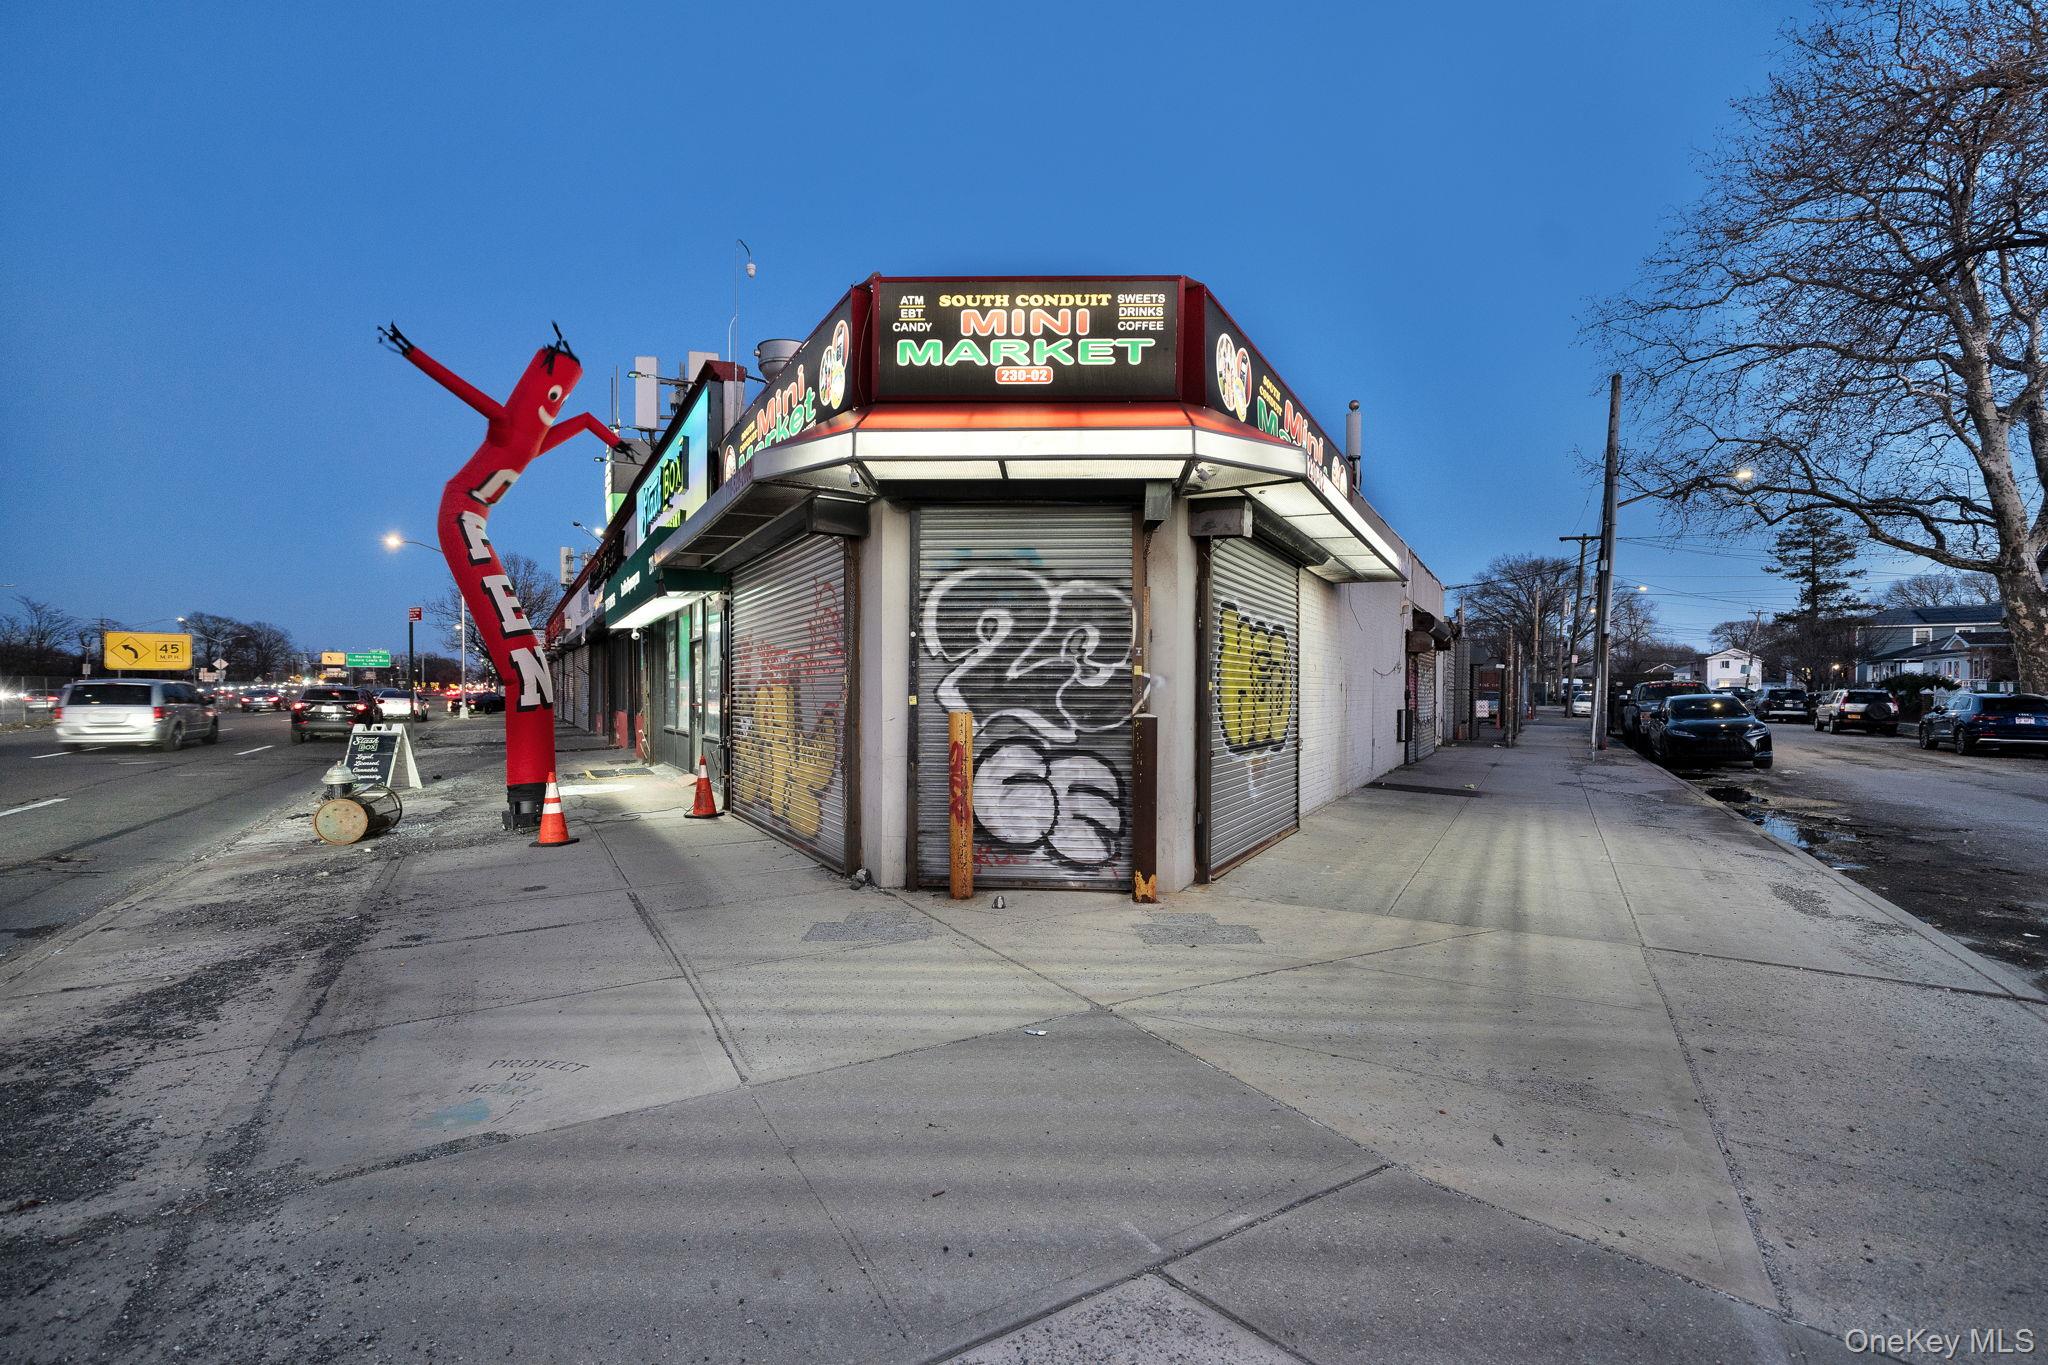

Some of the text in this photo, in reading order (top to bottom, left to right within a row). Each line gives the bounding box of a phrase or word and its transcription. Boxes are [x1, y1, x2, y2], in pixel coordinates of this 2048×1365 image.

[900, 295, 924, 305] ATM
[939, 293, 1112, 307] SOUTH CONDUIT
[1117, 293, 1166, 304] SWEETS
[900, 308, 924, 318] EBT
[1118, 306, 1164, 317] DRINKS
[892, 322, 933, 332] CANDY
[960, 308, 1090, 337] MINI
[1117, 320, 1165, 331] COFFEE
[896, 338, 1156, 367] MARKET
[1001, 369, 1048, 381] 230-02
[757, 364, 805, 441] Mini
[1284, 399, 1324, 466] Mini
[159, 644, 180, 654] 45
[353, 736, 379, 745] Stash
[488, 1060, 590, 1073] PROTECT
